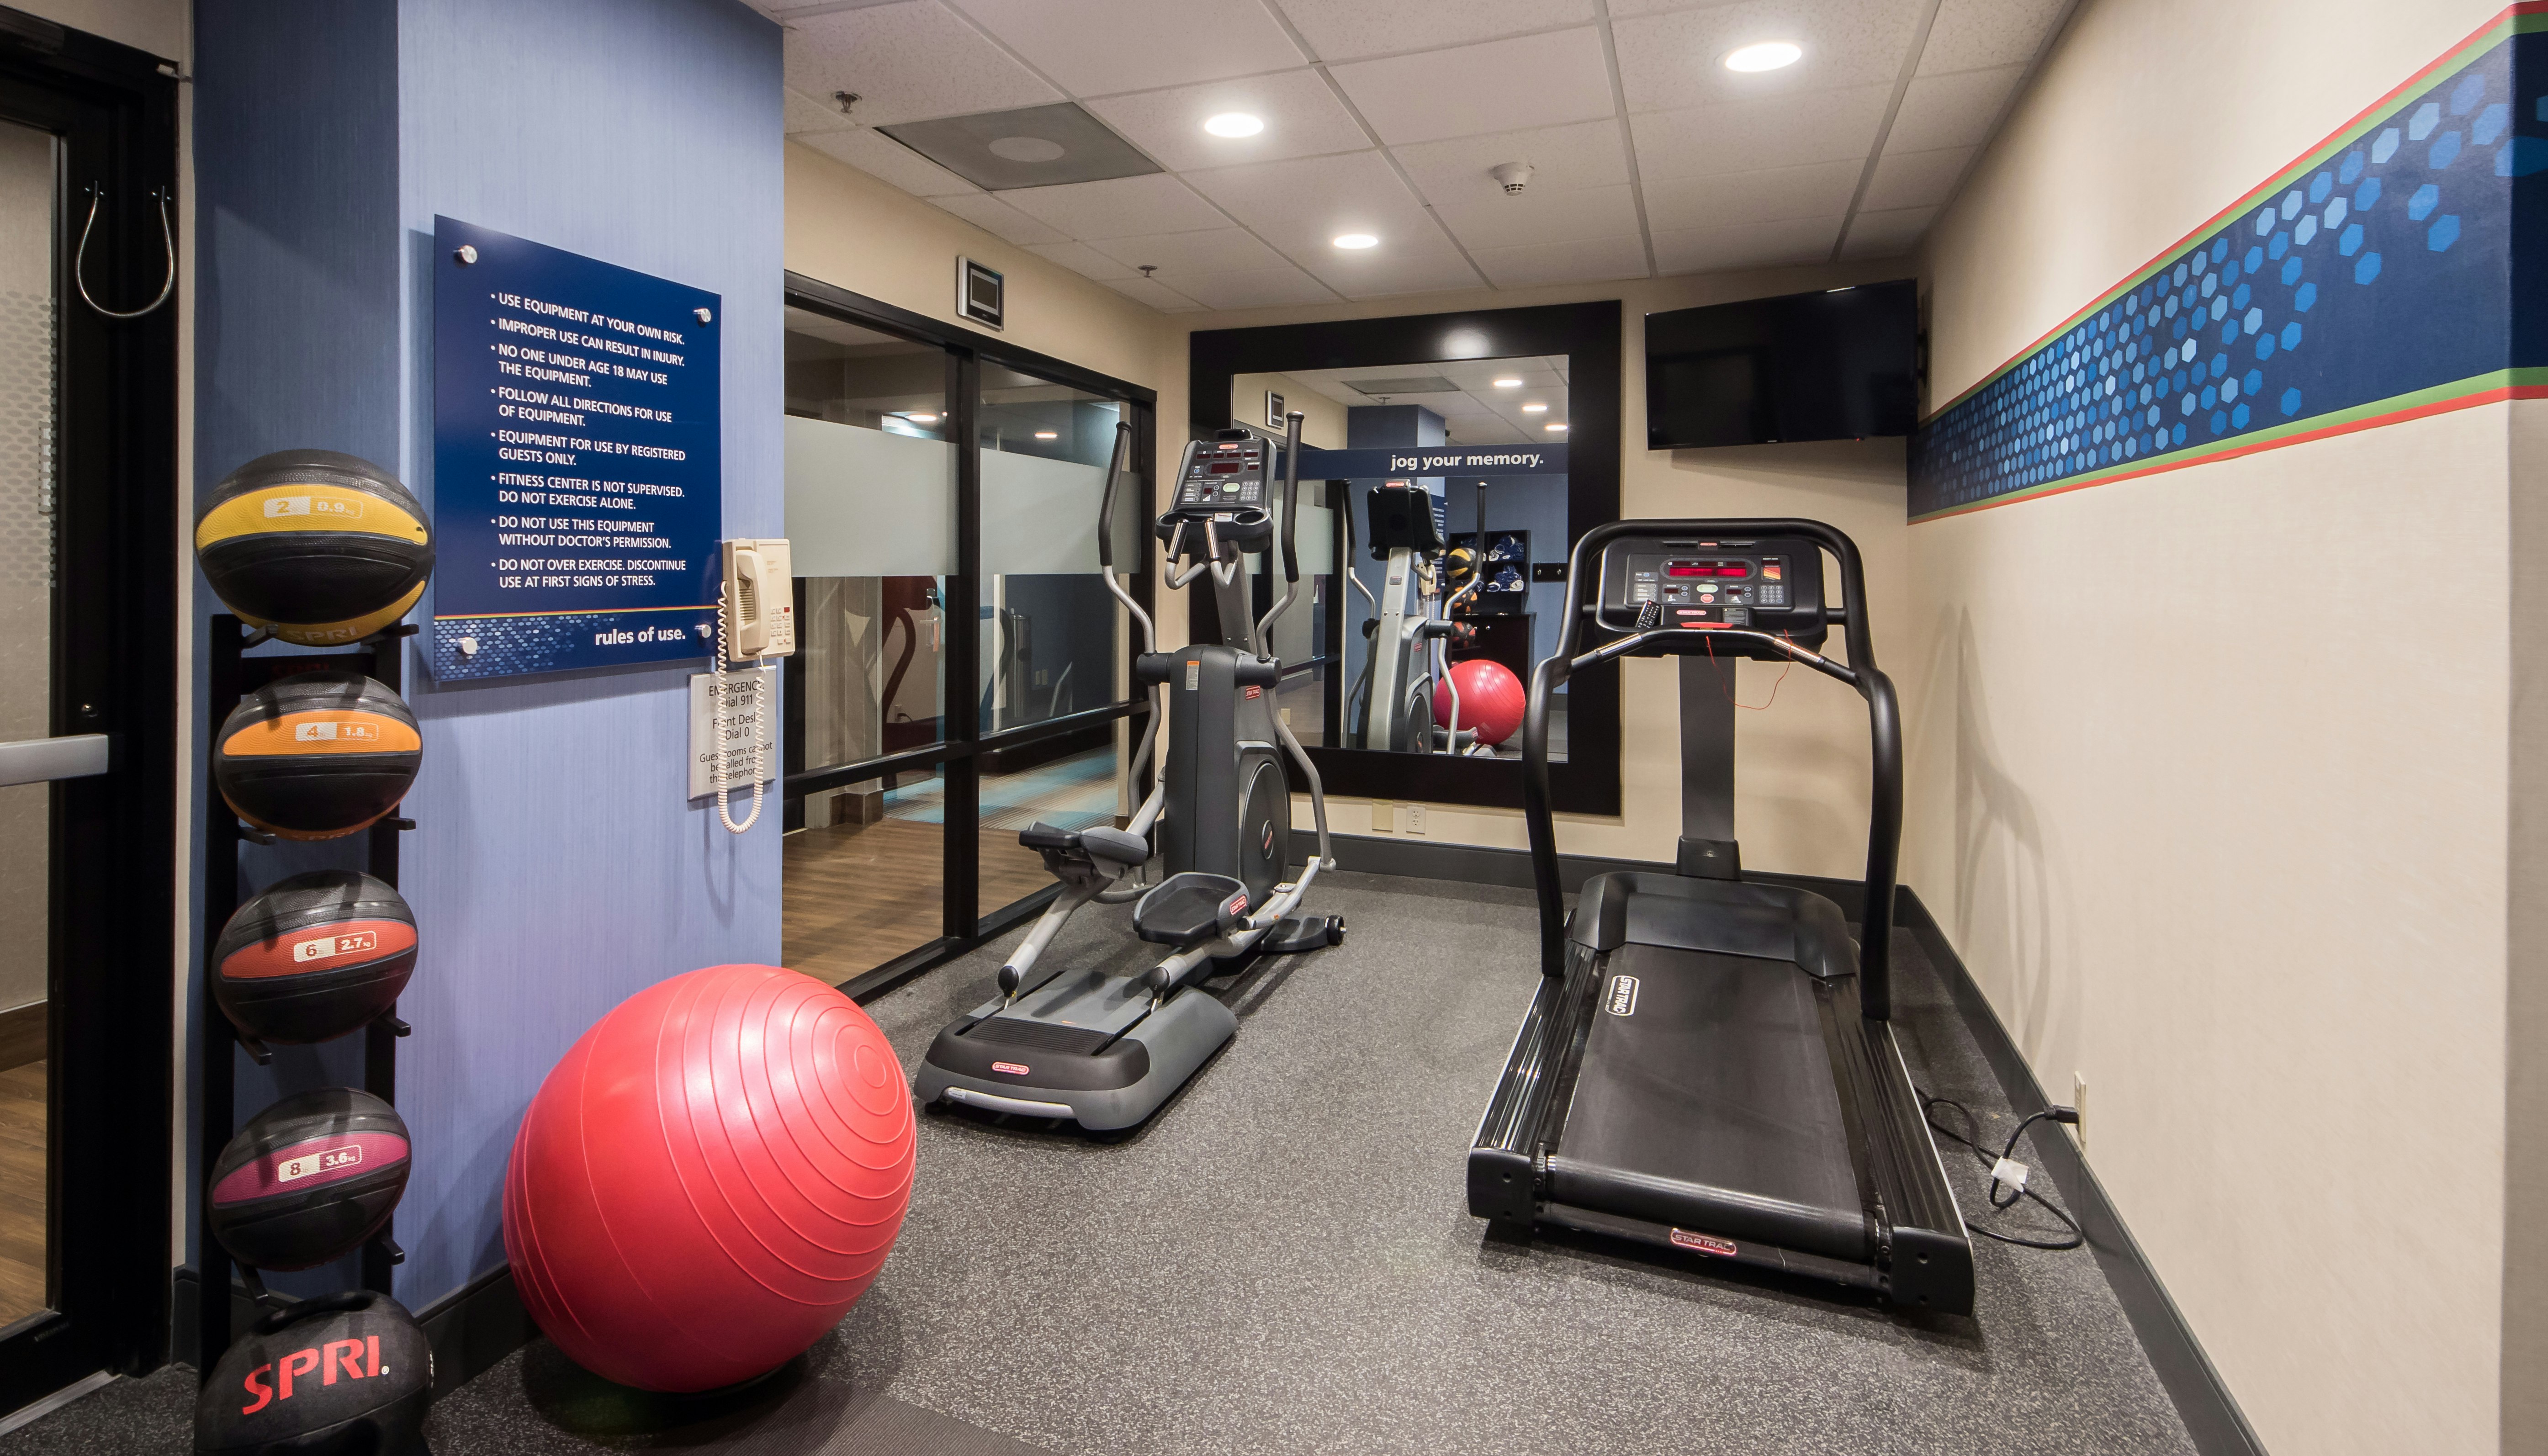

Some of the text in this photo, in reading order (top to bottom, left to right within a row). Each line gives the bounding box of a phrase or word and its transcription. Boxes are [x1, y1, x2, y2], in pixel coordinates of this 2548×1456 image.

[499, 293, 684, 344] USE EQUIPMENT AT YOUR OWN RISK.
[499, 318, 684, 366] IMPROPER USE CAN RESULT IN INJURY.
[499, 344, 667, 385] NO ONE UNDER AGE 18 MAY USE
[498, 361, 591, 387] THE EQUIPMENT.
[499, 387, 672, 422] FOLLOW ALL DIRECTIONS FOR USE
[499, 405, 585, 426] OF EQUIPMENT.
[499, 430, 685, 460] EQUIPMENT FOR USE BY REGISTERED
[499, 448, 576, 465] GUESTS ONLY.
[1391, 454, 1544, 471] jog your memory.
[499, 473, 684, 497] FITNESS CENTER IS NOT SUPERVISED.
[277, 501, 290, 514] 2
[500, 491, 636, 509] DO NOT EXERCISE ALONE.
[499, 516, 654, 532] DO NOT USE THIS EQUIPMENT
[499, 534, 555, 545] WITHOUT
[614, 537, 671, 548] PERMISSION.
[499, 559, 685, 570] DO NOT OVER EXERCISE. DISCONTINUE
[500, 576, 655, 588] USE AT FIRST SIGNS OF STRESS.
[596, 626, 685, 645] rules of use.
[741, 694, 752, 705] 911
[307, 725, 319, 737] 4
[713, 716, 736, 729] Fnt
[726, 727, 741, 740] Dial
[699, 753, 720, 762] Gues
[748, 741, 773, 753] canot
[726, 757, 743, 769] alled
[746, 755, 758, 765] fro
[306, 944, 317, 957] 6
[1613, 976, 1632, 1013] STAR TRAC
[290, 1162, 301, 1176] 8
[1673, 1235, 1731, 1251] STAR TRAC
